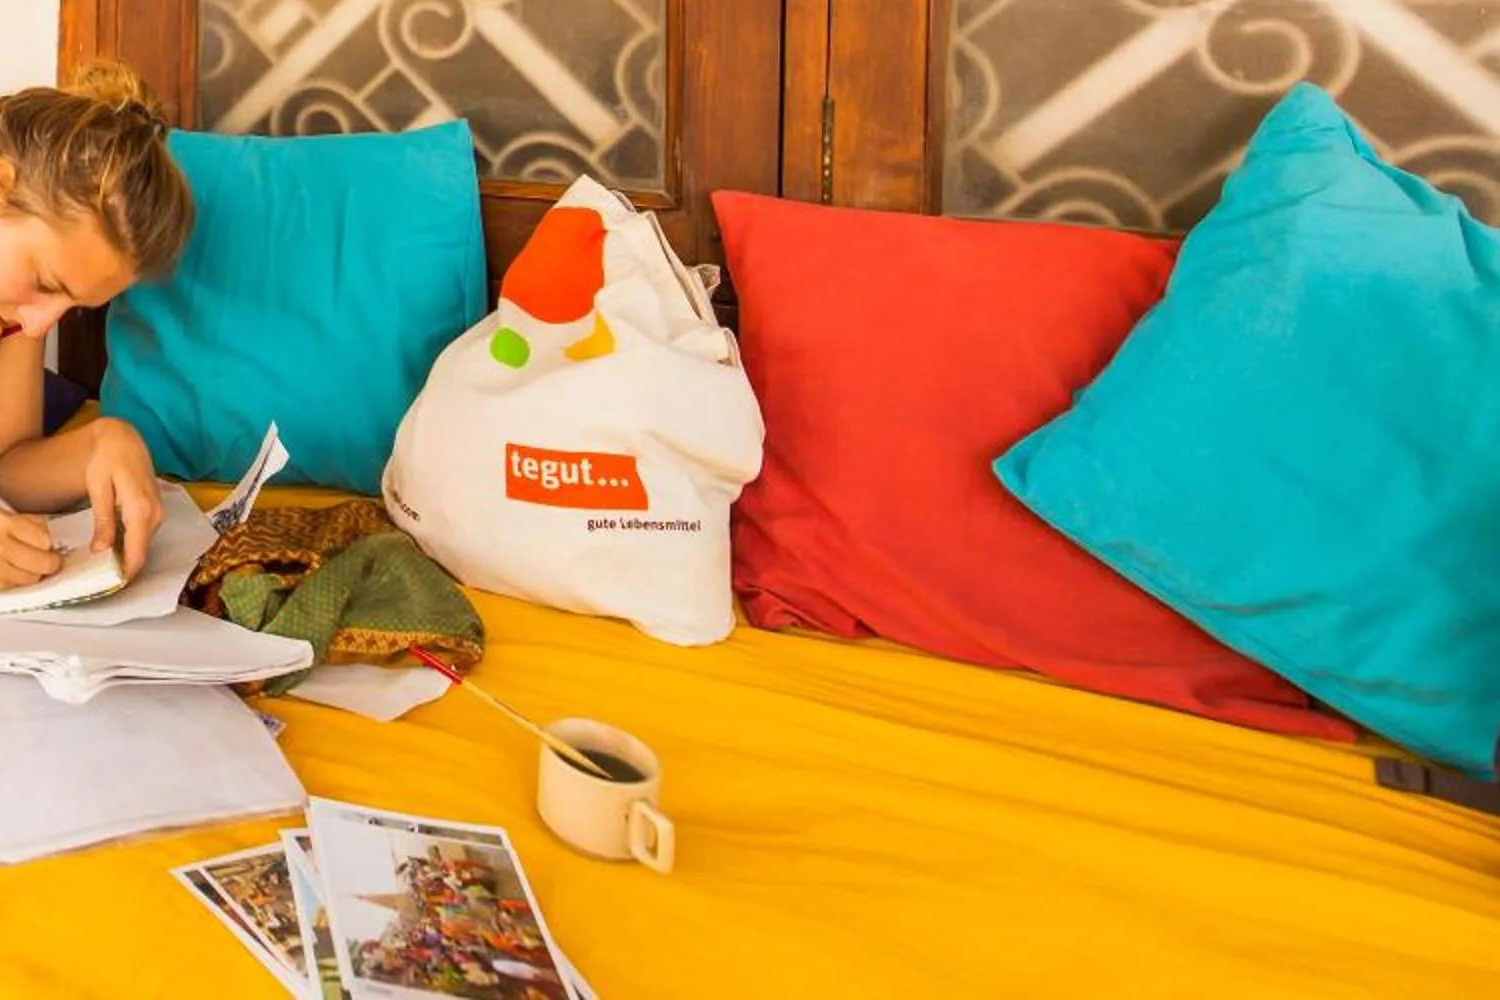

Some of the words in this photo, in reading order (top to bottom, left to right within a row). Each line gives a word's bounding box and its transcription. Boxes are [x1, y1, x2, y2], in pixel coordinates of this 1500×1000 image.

[510, 450, 630, 489] tegut...
[587, 518, 617, 532] gute
[619, 517, 702, 532] Lebensmittel
